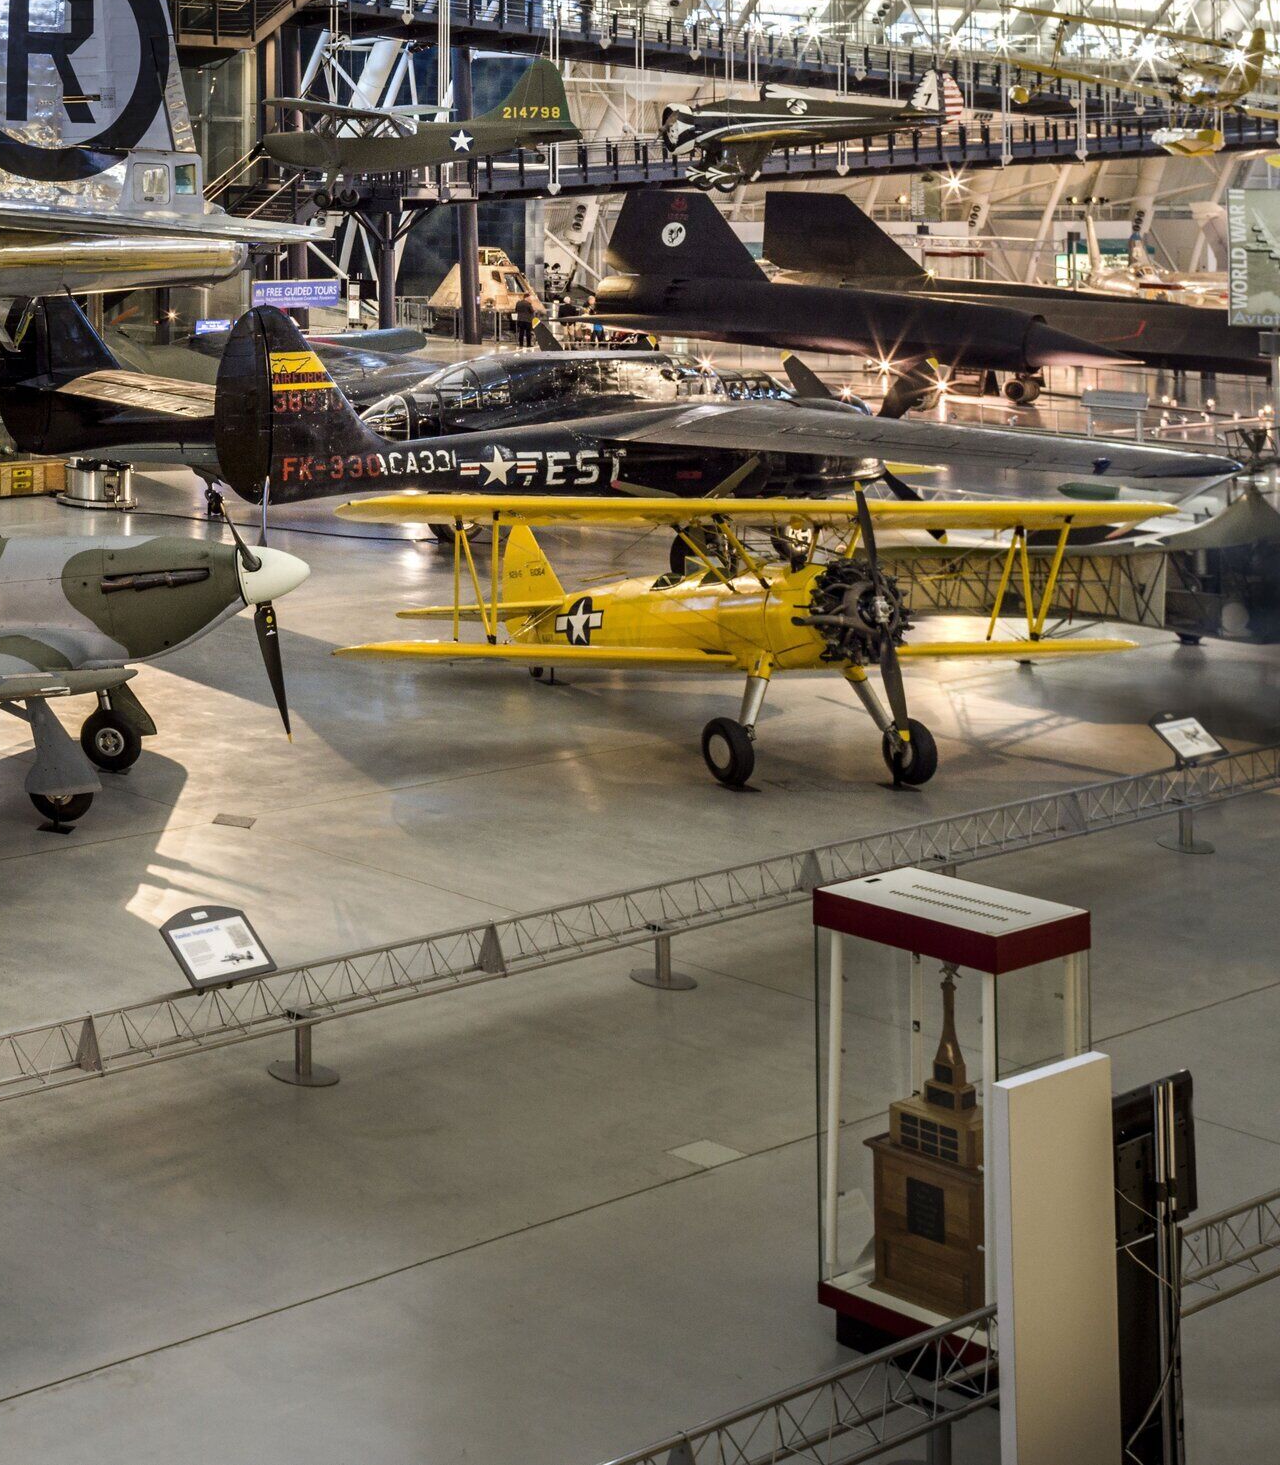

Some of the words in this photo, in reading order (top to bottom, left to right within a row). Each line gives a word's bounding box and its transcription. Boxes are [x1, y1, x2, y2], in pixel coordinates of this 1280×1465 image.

[924, 93, 932, 105] 7
[502, 106, 560, 119] 214798
[1228, 189, 1245, 199] II
[1229, 205, 1247, 243] WAR
[1231, 247, 1248, 309] WORLD
[266, 287, 283, 297] FREE
[284, 286, 312, 296] GUIDED
[313, 285, 337, 295] TOURS
[282, 454, 380, 481] FK-330
